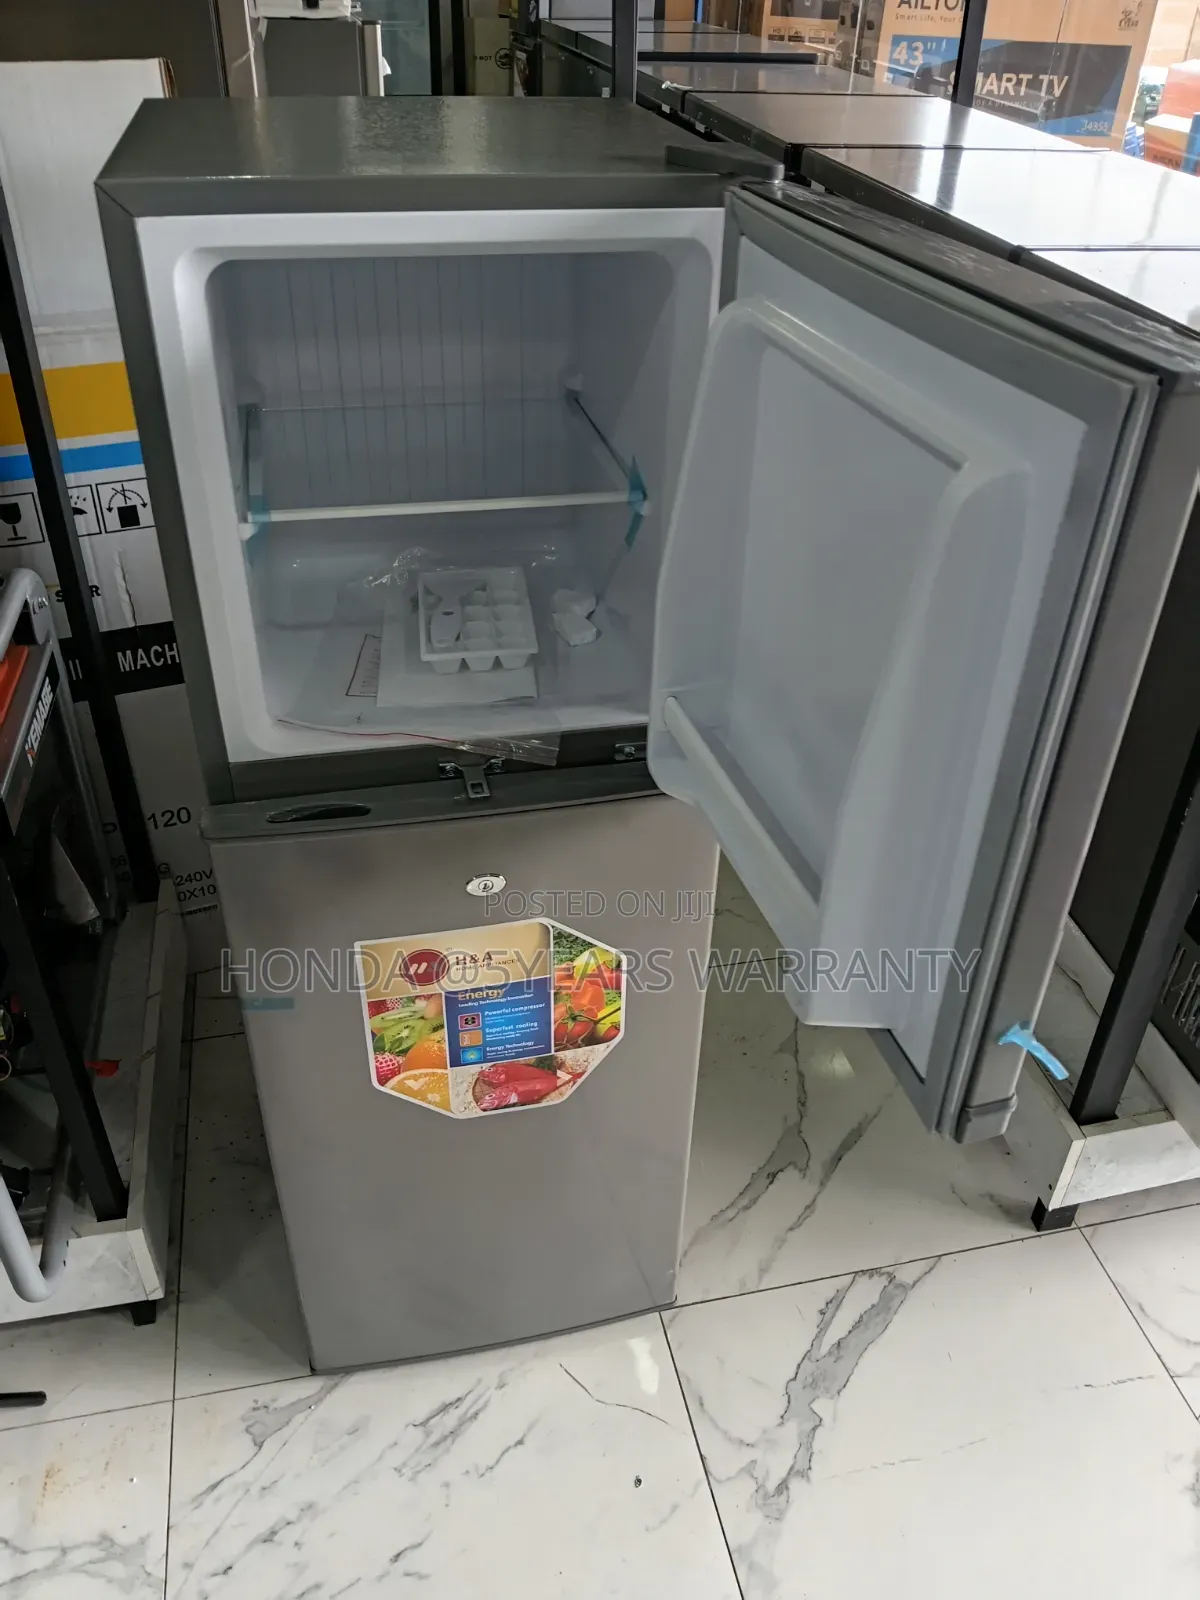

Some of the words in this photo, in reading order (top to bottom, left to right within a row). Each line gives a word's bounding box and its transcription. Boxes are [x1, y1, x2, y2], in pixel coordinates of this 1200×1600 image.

[1038, 74, 1069, 98] TV
[147, 806, 192, 830] 120
[455, 951, 493, 965] H&A
[458, 988, 505, 1000] Energy
[458, 1000, 478, 1008] Leading
[479, 996, 507, 1005] Technology
[484, 1007, 511, 1015] Powerful
[512, 1003, 545, 1012] compressor
[485, 1025, 513, 1033] Superfast
[515, 1021, 538, 1029] cooling
[486, 1044, 505, 1052] Energy
[505, 1040, 534, 1048] Technology
